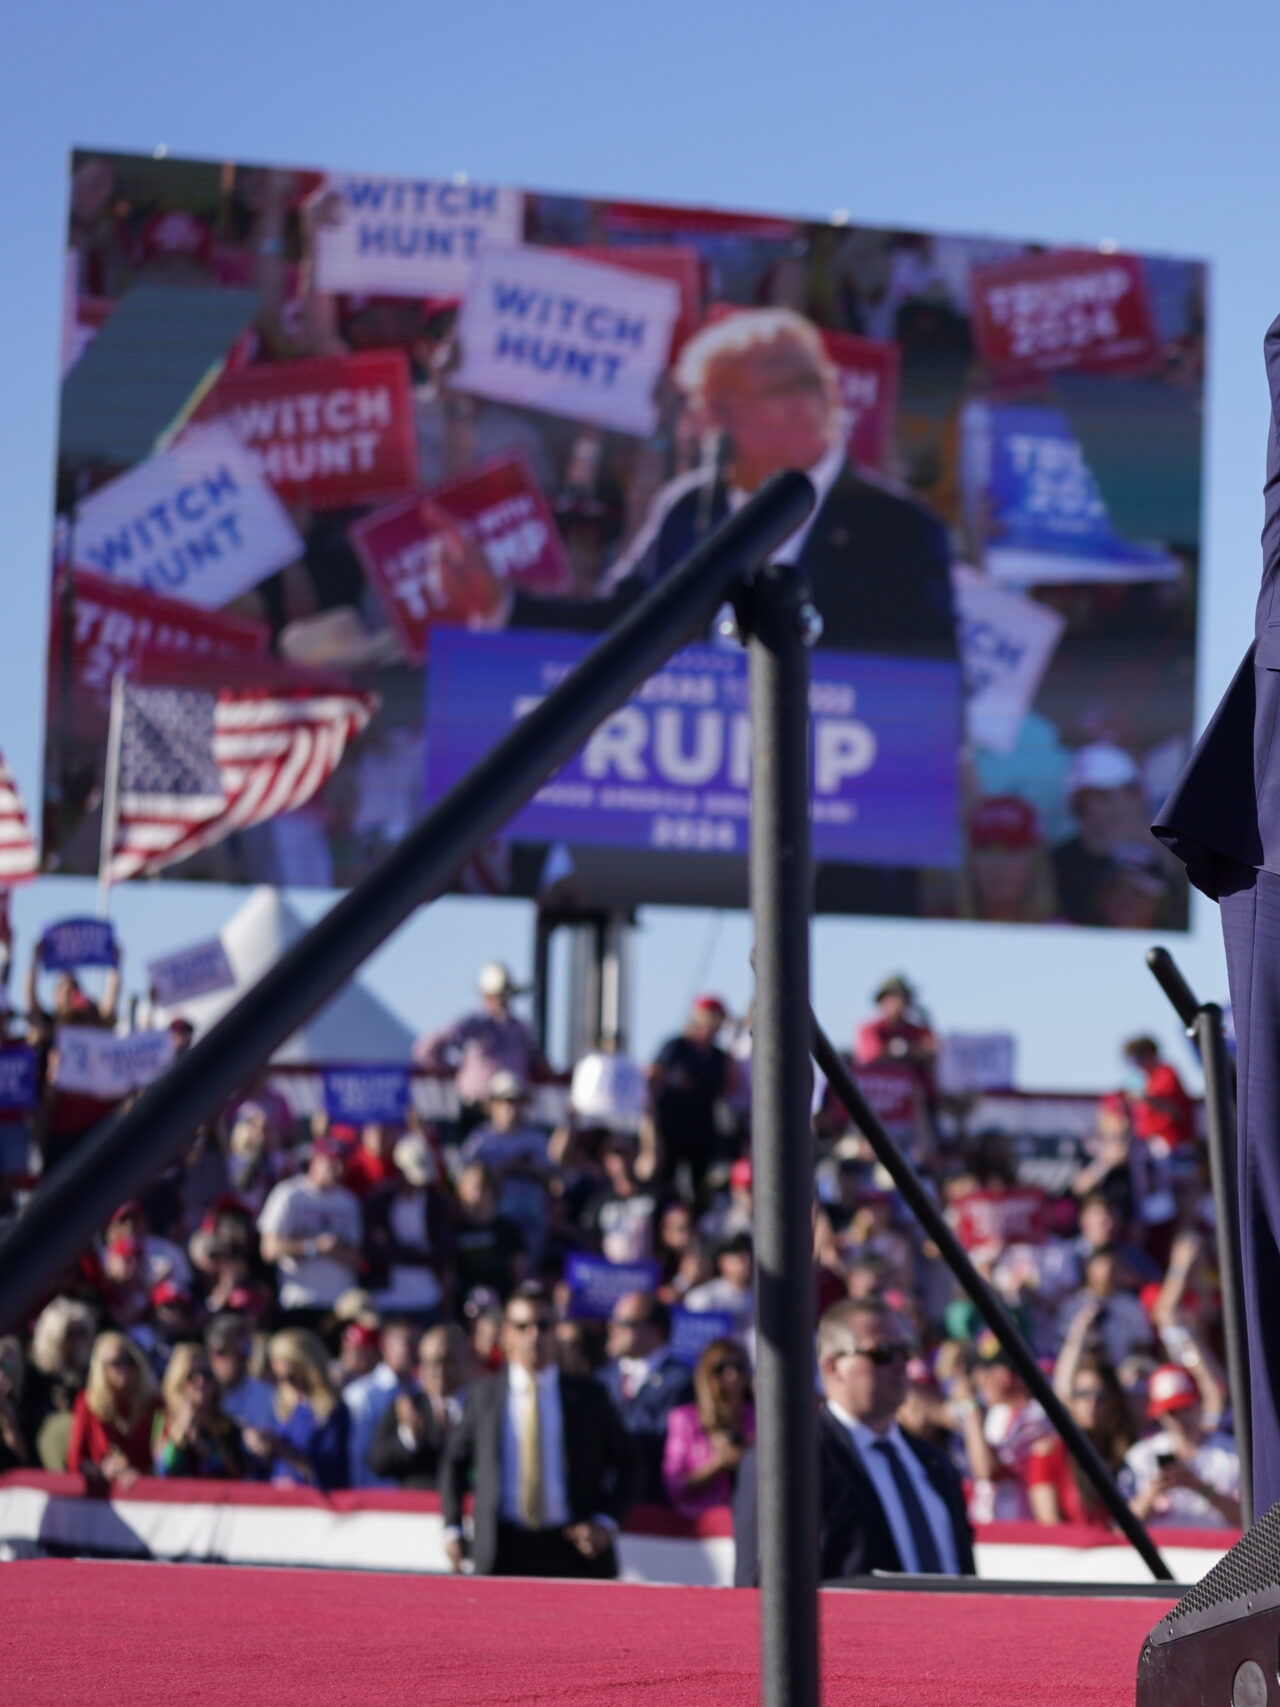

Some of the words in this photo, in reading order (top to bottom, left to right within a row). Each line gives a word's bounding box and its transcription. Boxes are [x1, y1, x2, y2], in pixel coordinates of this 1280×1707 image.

[349, 181, 497, 216] WITCH
[358, 223, 481, 257] HUNT
[493, 279, 646, 347] WITCH
[496, 328, 624, 386] HUNT
[237, 387, 390, 440] WITCH
[88, 465, 239, 571] WITCH
[513, 696, 877, 795] RUP
